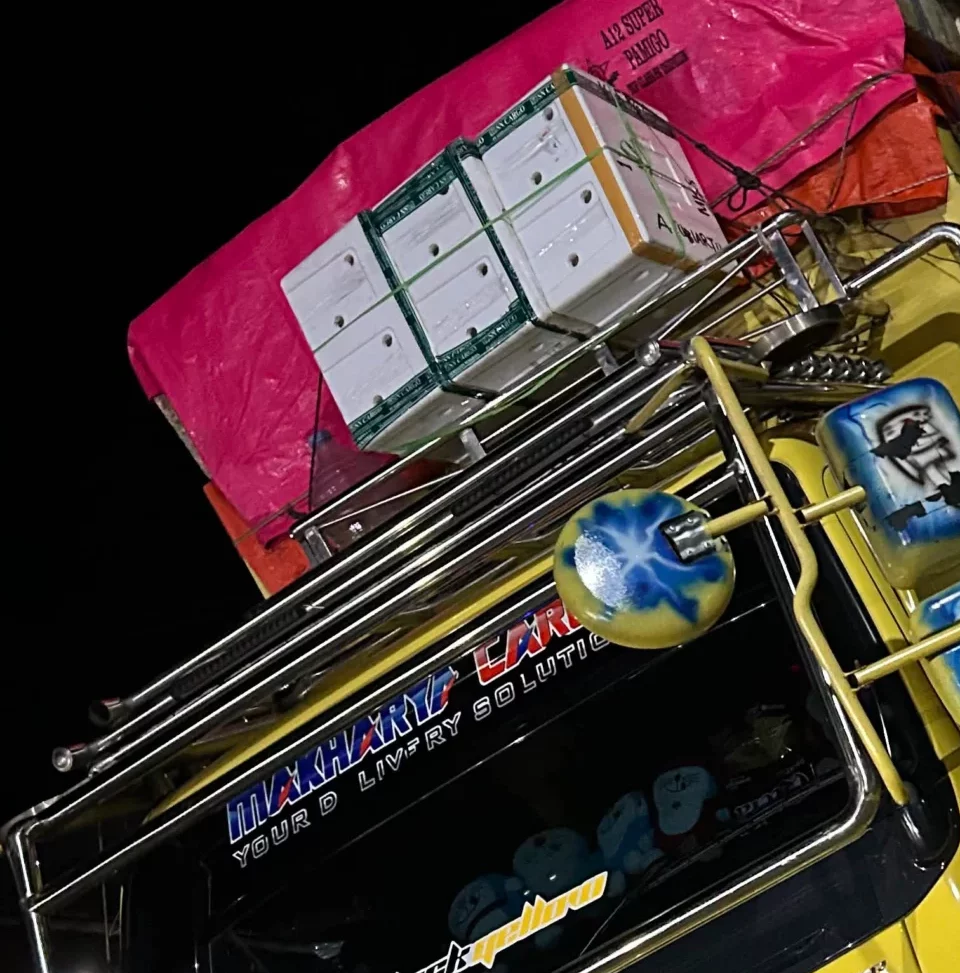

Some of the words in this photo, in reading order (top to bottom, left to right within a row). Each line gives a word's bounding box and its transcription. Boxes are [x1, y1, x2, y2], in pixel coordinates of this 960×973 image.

[621, 0, 665, 36] SUPER
[623, 28, 670, 70] PAMIGO
[231, 807, 312, 869] YOUR
